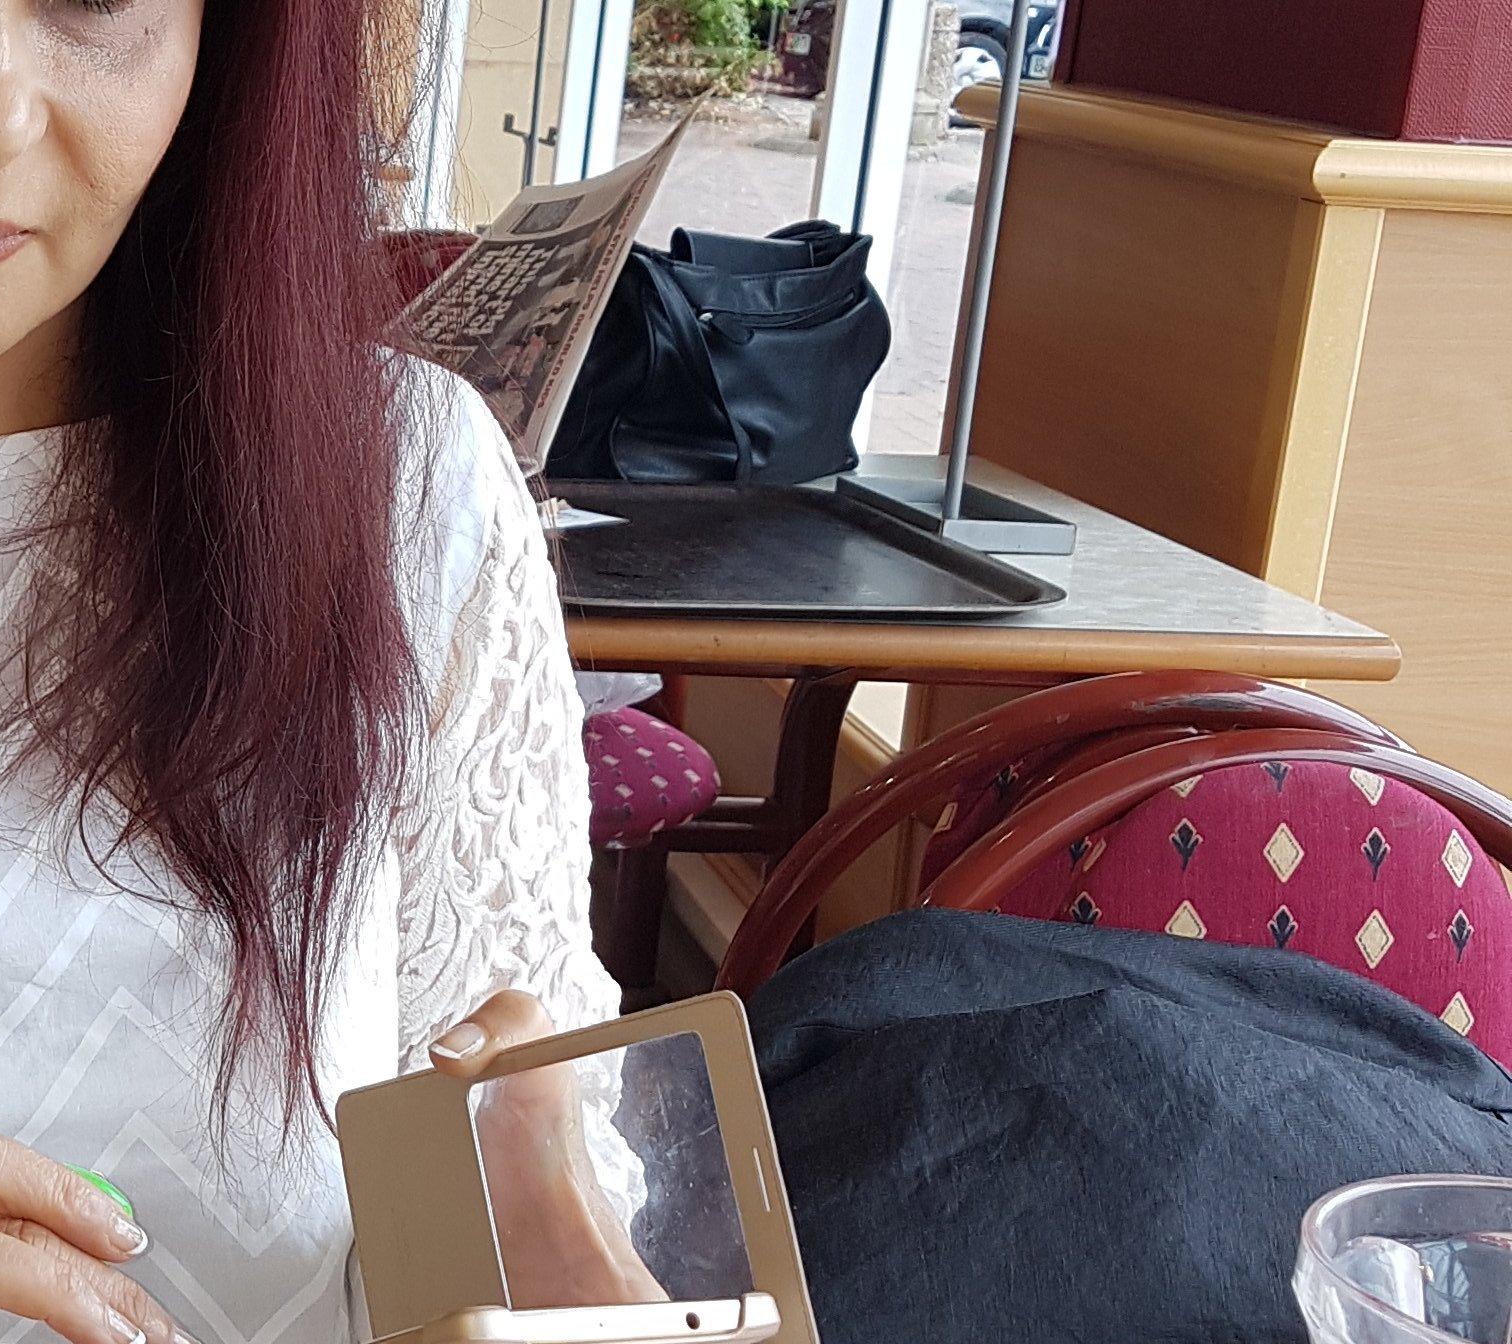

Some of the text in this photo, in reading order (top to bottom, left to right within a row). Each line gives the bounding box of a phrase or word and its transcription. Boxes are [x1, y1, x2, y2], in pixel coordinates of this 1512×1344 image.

[481, 248, 546, 309] heart
[583, 269, 605, 310] HELPS
[552, 313, 585, 376] DISABLED
[538, 378, 555, 408] KIDS
